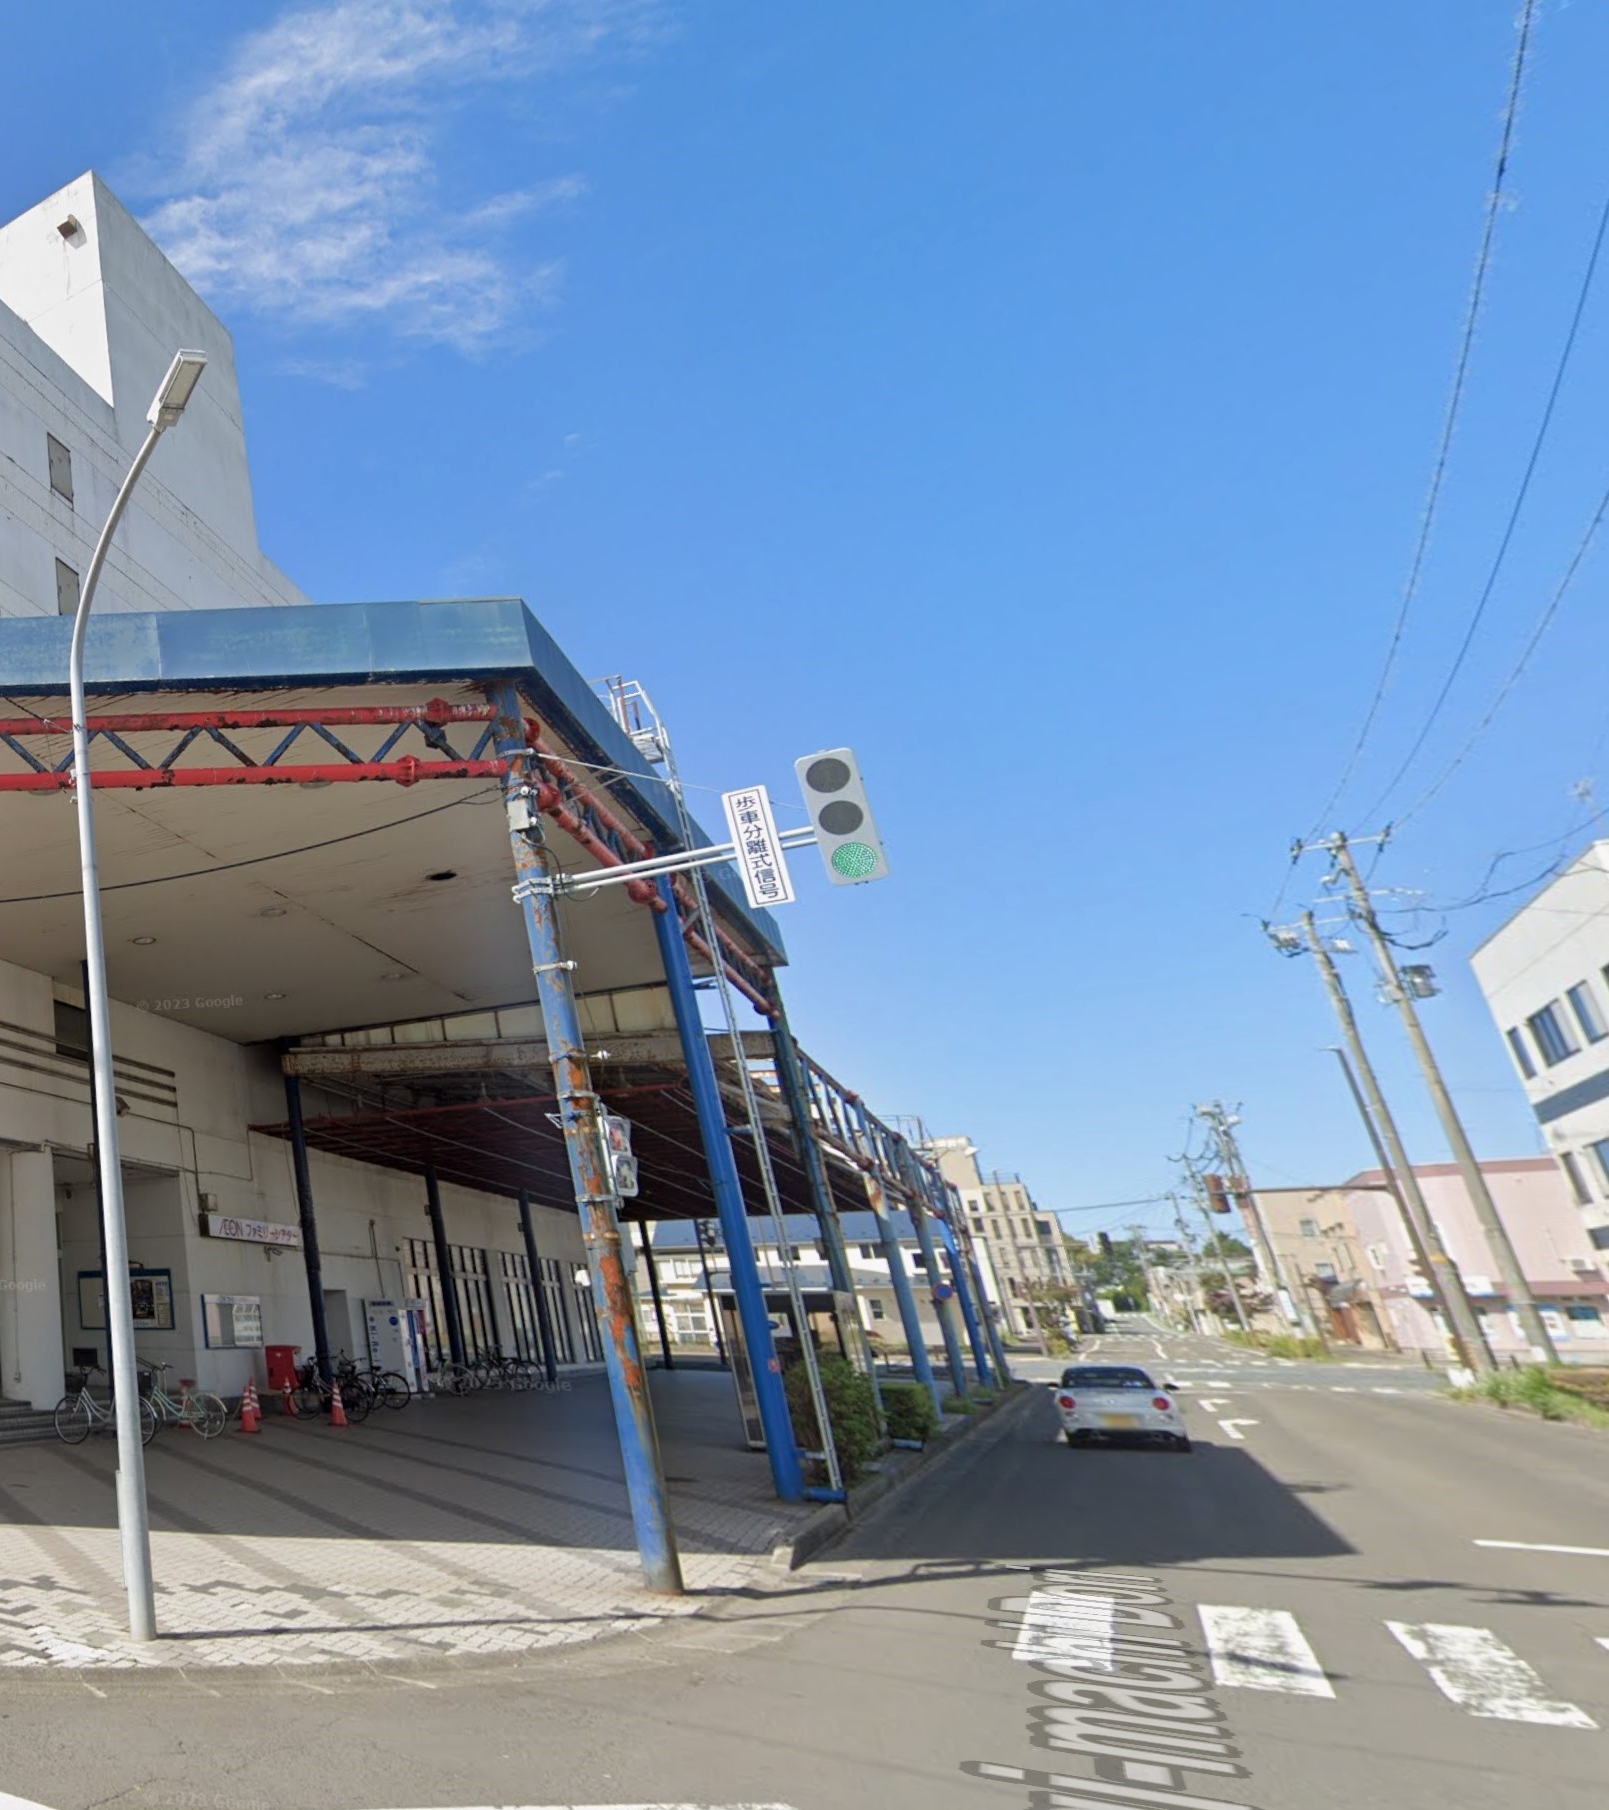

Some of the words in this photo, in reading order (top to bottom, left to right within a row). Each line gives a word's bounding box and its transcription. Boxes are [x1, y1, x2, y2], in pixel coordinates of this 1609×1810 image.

[736, 796, 779, 899] 歩車分離式信号
